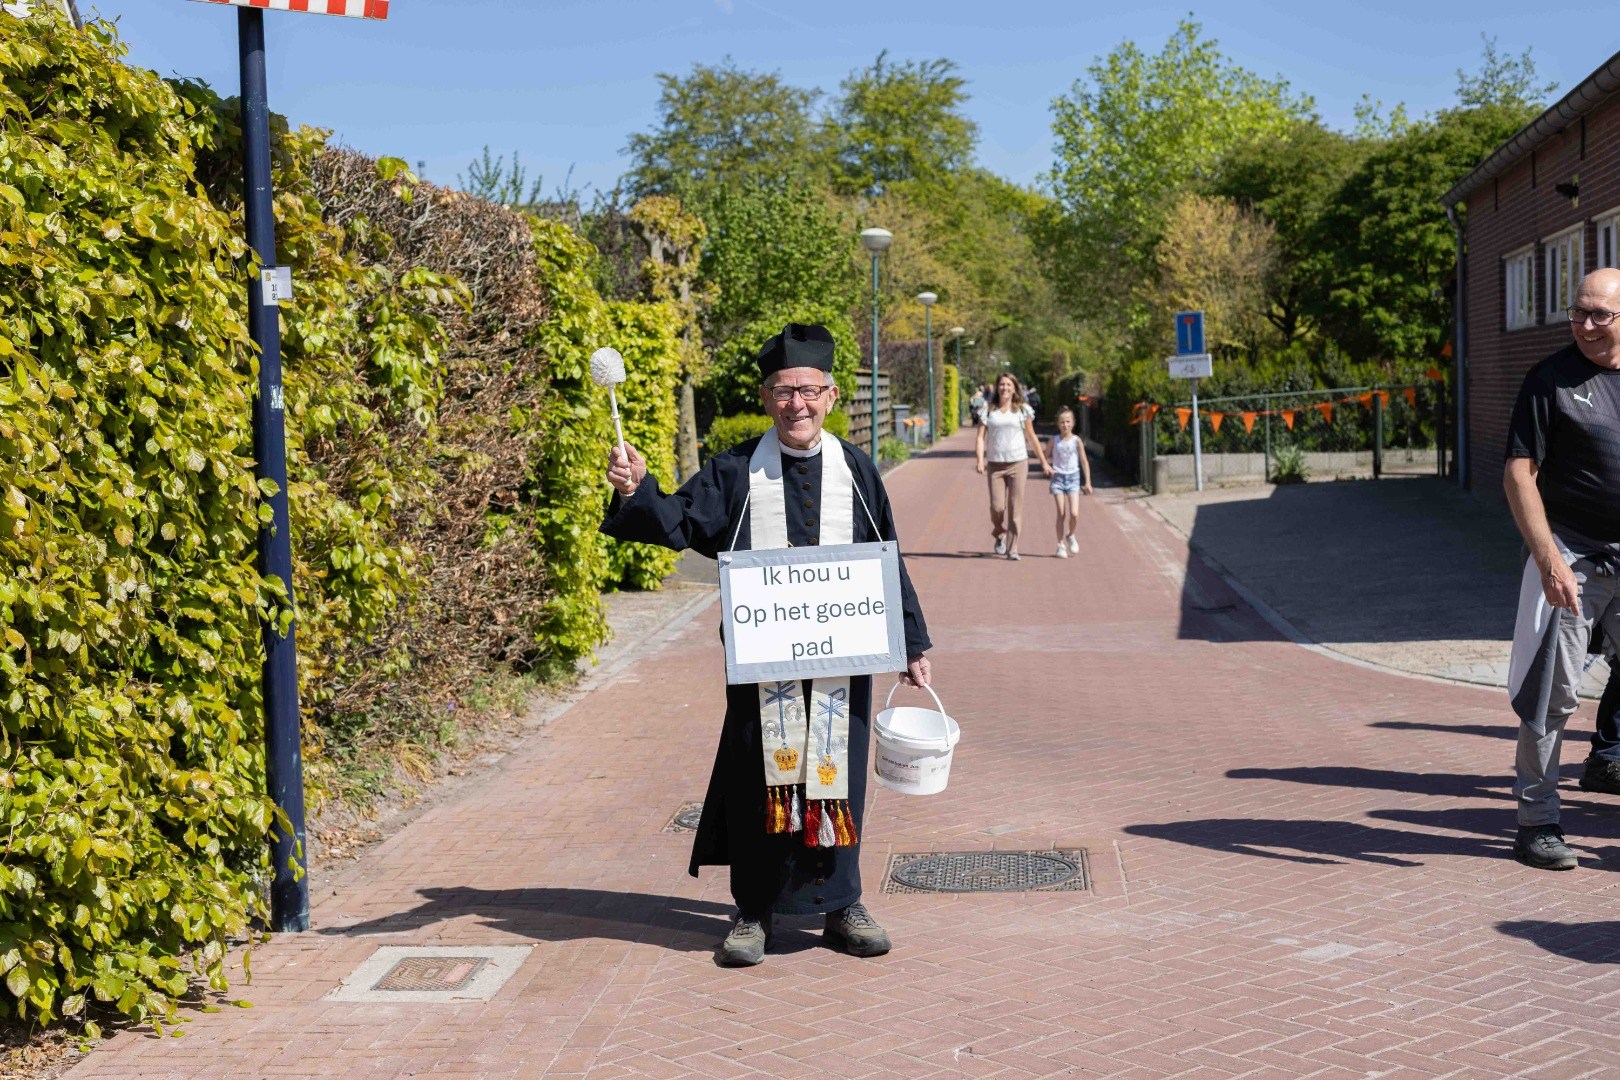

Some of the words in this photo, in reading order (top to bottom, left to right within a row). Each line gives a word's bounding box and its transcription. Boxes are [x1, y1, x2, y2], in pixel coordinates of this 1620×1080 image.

[763, 566, 783, 586] Ik
[788, 565, 830, 584] hou
[838, 566, 850, 581] u
[733, 604, 767, 628] Op
[773, 602, 811, 622] het
[816, 596, 885, 624] goede
[791, 636, 834, 661] pad
